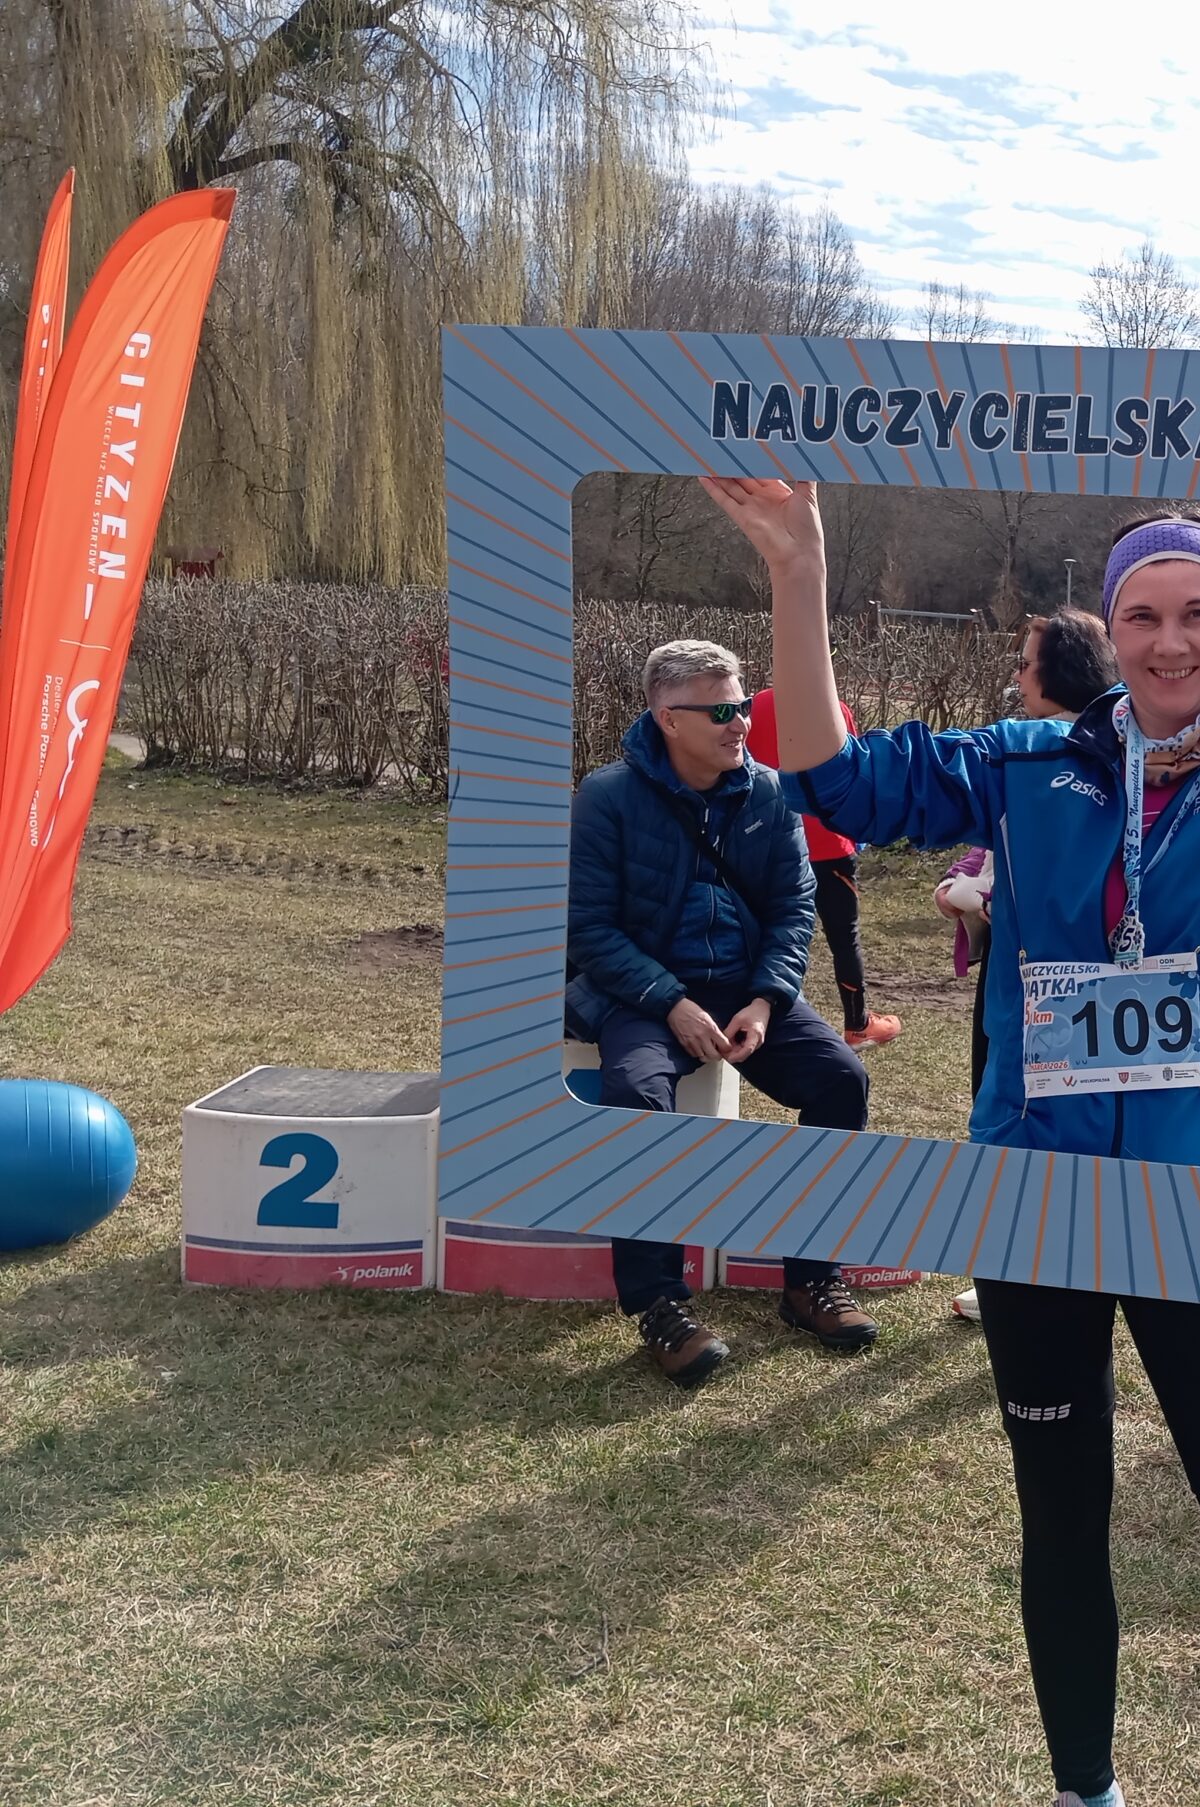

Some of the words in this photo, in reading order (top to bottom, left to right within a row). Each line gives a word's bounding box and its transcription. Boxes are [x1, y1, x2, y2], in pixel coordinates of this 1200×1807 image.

[98, 331, 152, 581] CITYZEN
[87, 511, 100, 575] SPORTOWY
[40, 673, 53, 731] Porsche
[1070, 775, 1109, 807] asics
[1119, 927, 1135, 952] 5
[1025, 978, 1076, 1001] IĄTKA
[1033, 1011, 1053, 1023] km
[1072, 996, 1193, 1057] 109
[1049, 1061, 1069, 1070] 2026
[257, 1132, 341, 1230] 2
[353, 1263, 414, 1282] polanik
[860, 1269, 913, 1285] polanik
[1007, 1401, 1072, 1421] GUESS
